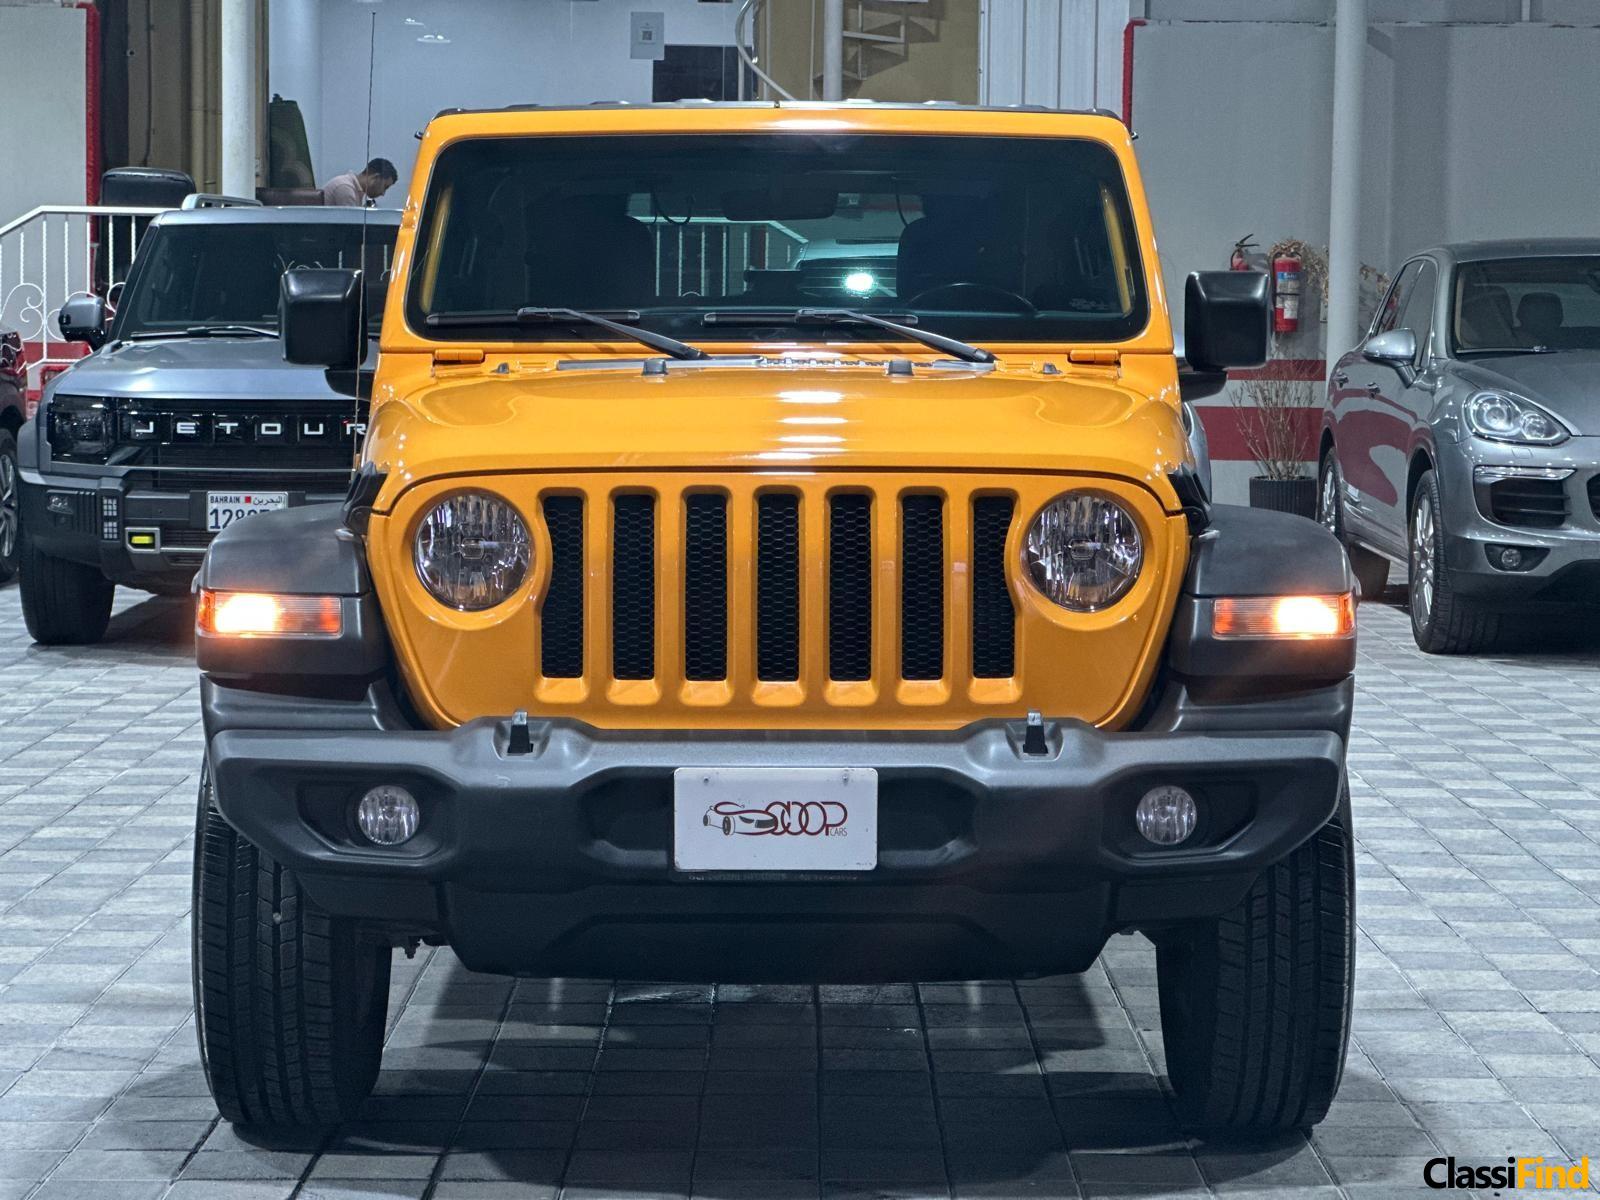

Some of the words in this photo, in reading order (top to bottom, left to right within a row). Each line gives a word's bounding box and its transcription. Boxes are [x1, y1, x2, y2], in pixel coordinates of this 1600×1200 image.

[135, 421, 367, 436] JETOUR
[210, 495, 241, 504] BAHRAIN
[253, 495, 283, 506] البحرين
[829, 828, 848, 837] CARS
